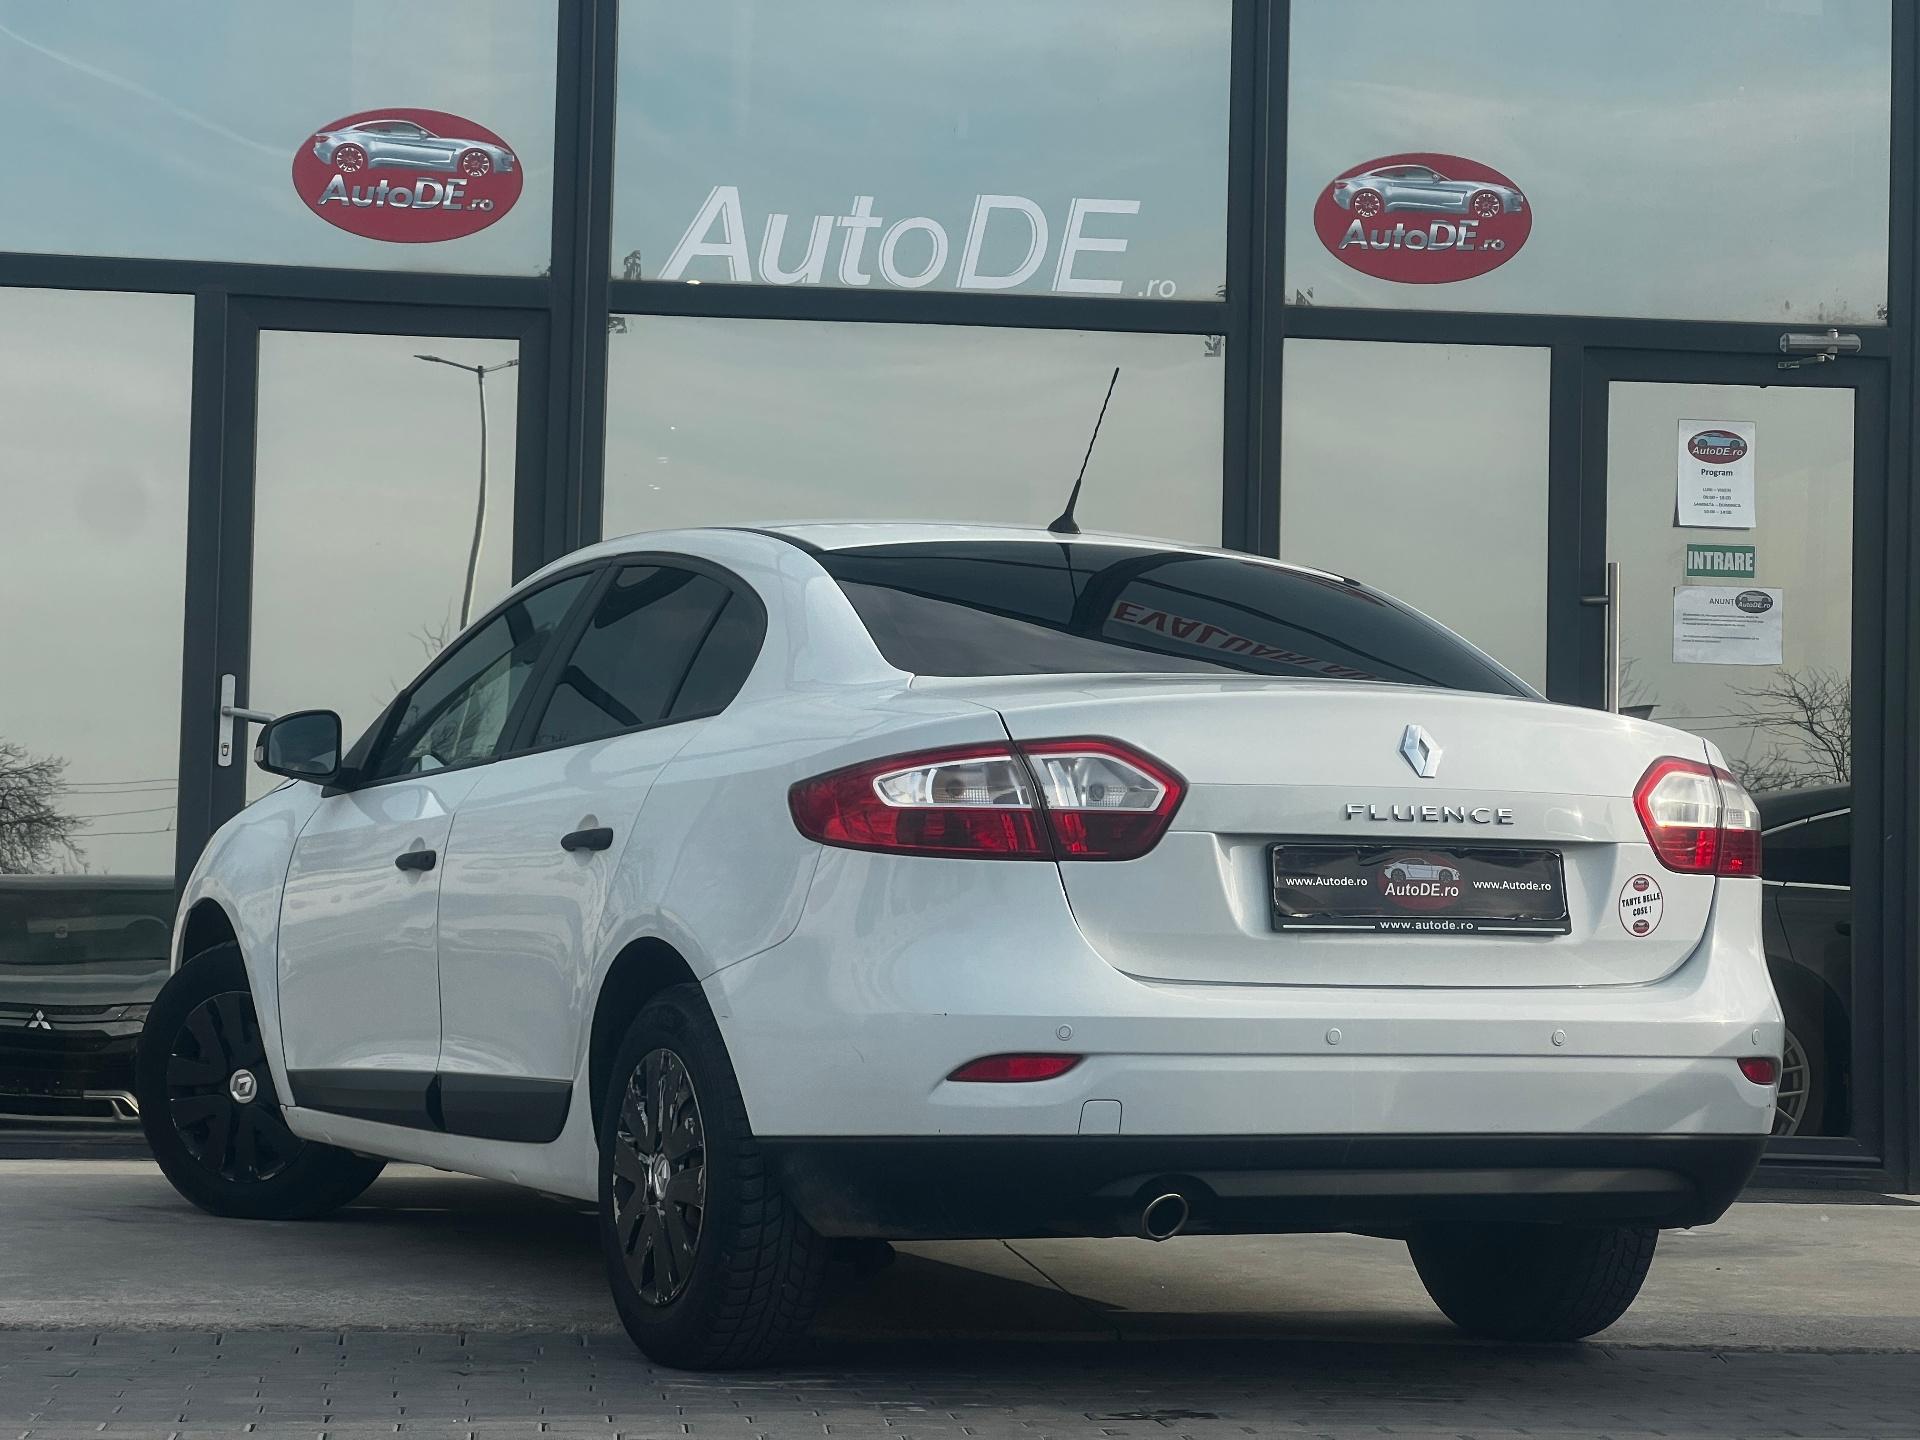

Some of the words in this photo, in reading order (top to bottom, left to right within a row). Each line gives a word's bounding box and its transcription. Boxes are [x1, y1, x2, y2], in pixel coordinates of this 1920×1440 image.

[1692, 446, 1744, 456] AutoDE.ro
[1701, 468, 1733, 477] Program
[1687, 551, 1754, 571] INTRARE
[1345, 803, 1515, 825] FLUENCE
[1285, 876, 1368, 887] www.Autode.ro
[1472, 879, 1552, 891] www.Autode.ro
[1384, 882, 1459, 898] AutoDE.ro
[1642, 892, 1661, 903] BELLE
[1632, 906, 1648, 916] COSE
[1380, 920, 1474, 931] www.autode.ro
